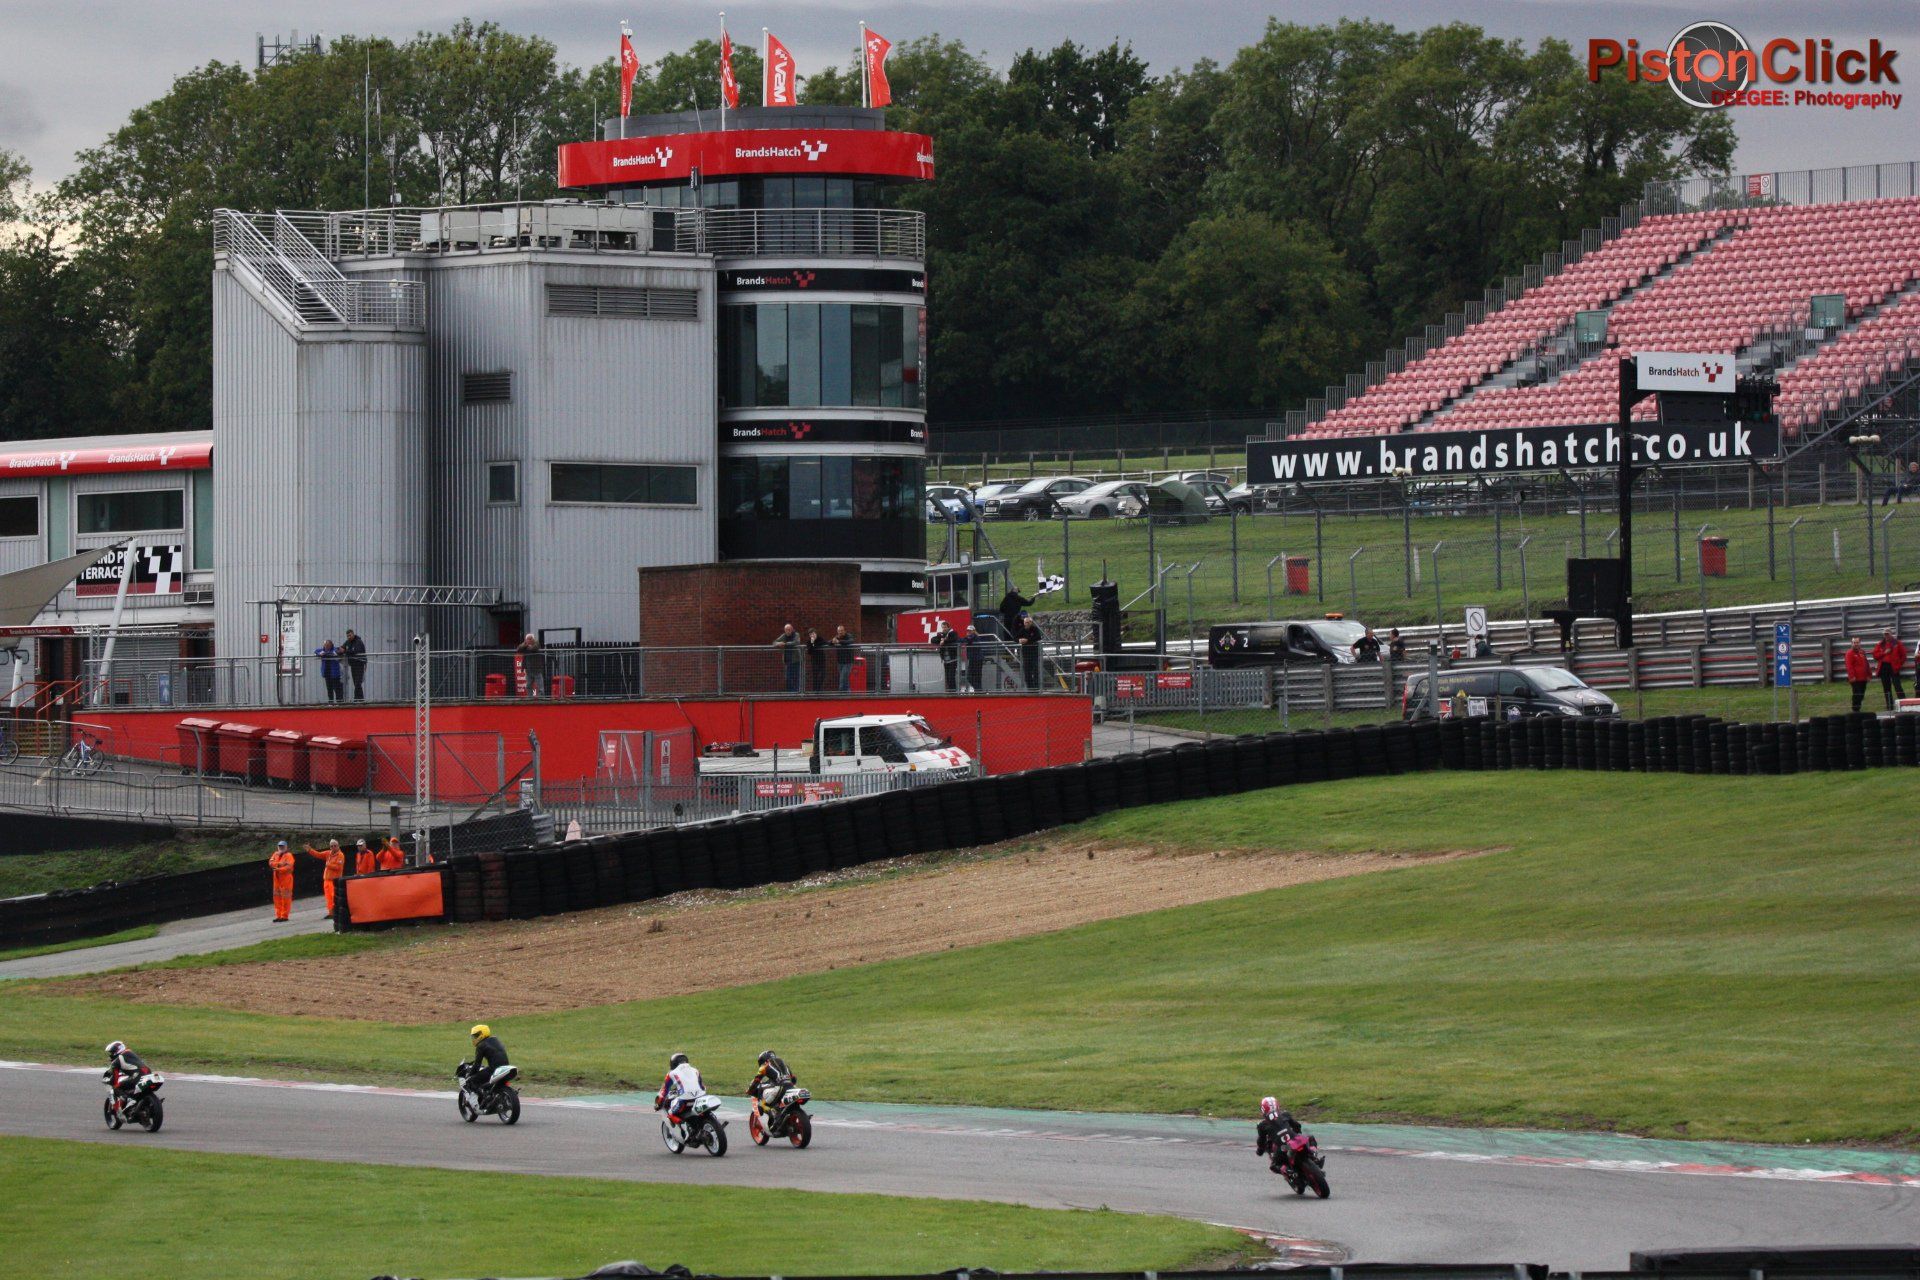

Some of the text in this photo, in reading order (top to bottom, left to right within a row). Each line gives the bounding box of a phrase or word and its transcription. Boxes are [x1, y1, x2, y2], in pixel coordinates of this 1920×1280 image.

[735, 147, 801, 158] BrandsHatch
[613, 154, 656, 167] BrandsHatch
[736, 277, 791, 286] BrandsHatch
[1648, 366, 1700, 377] BrandsHatch
[733, 428, 788, 437] BrandsHatch
[1271, 421, 1752, 479] www.brandshatch.co.uk
[9, 456, 56, 468] BrandsHatch
[107, 452, 156, 463] BrandsHatch
[1243, 637, 1249, 648] 2
